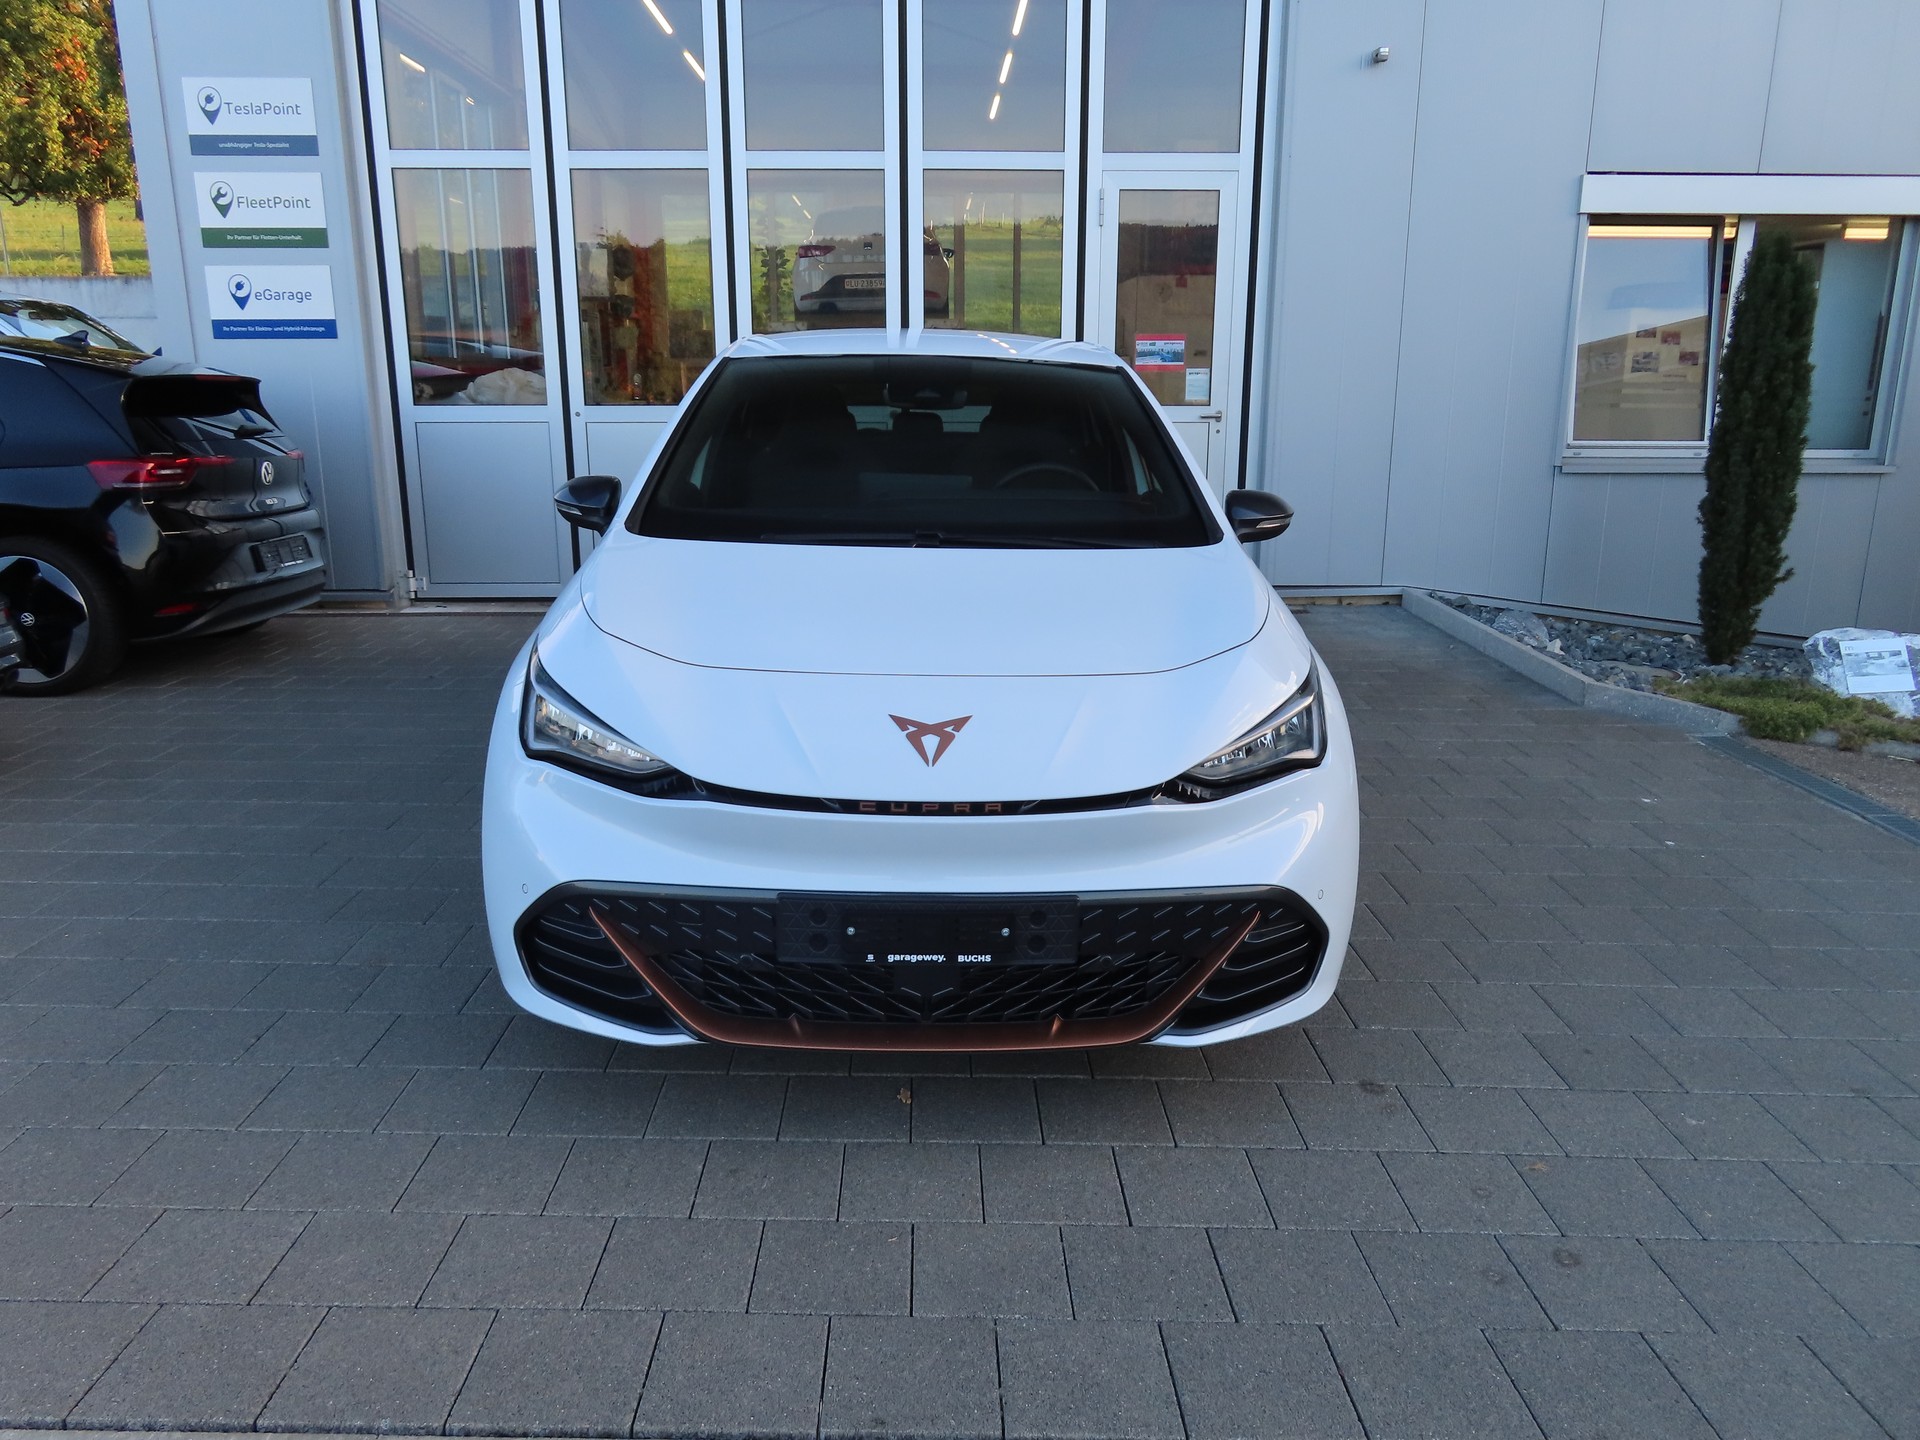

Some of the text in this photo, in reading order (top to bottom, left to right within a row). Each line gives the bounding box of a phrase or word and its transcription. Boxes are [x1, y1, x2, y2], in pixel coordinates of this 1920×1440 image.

[223, 102, 301, 116] TeslaPoint
[236, 196, 311, 209] FleetPoint
[254, 288, 312, 303] eGarage
[859, 801, 1002, 813] CUPRA
[887, 953, 947, 963] garagewey.
[957, 954, 992, 963] BUCHS
